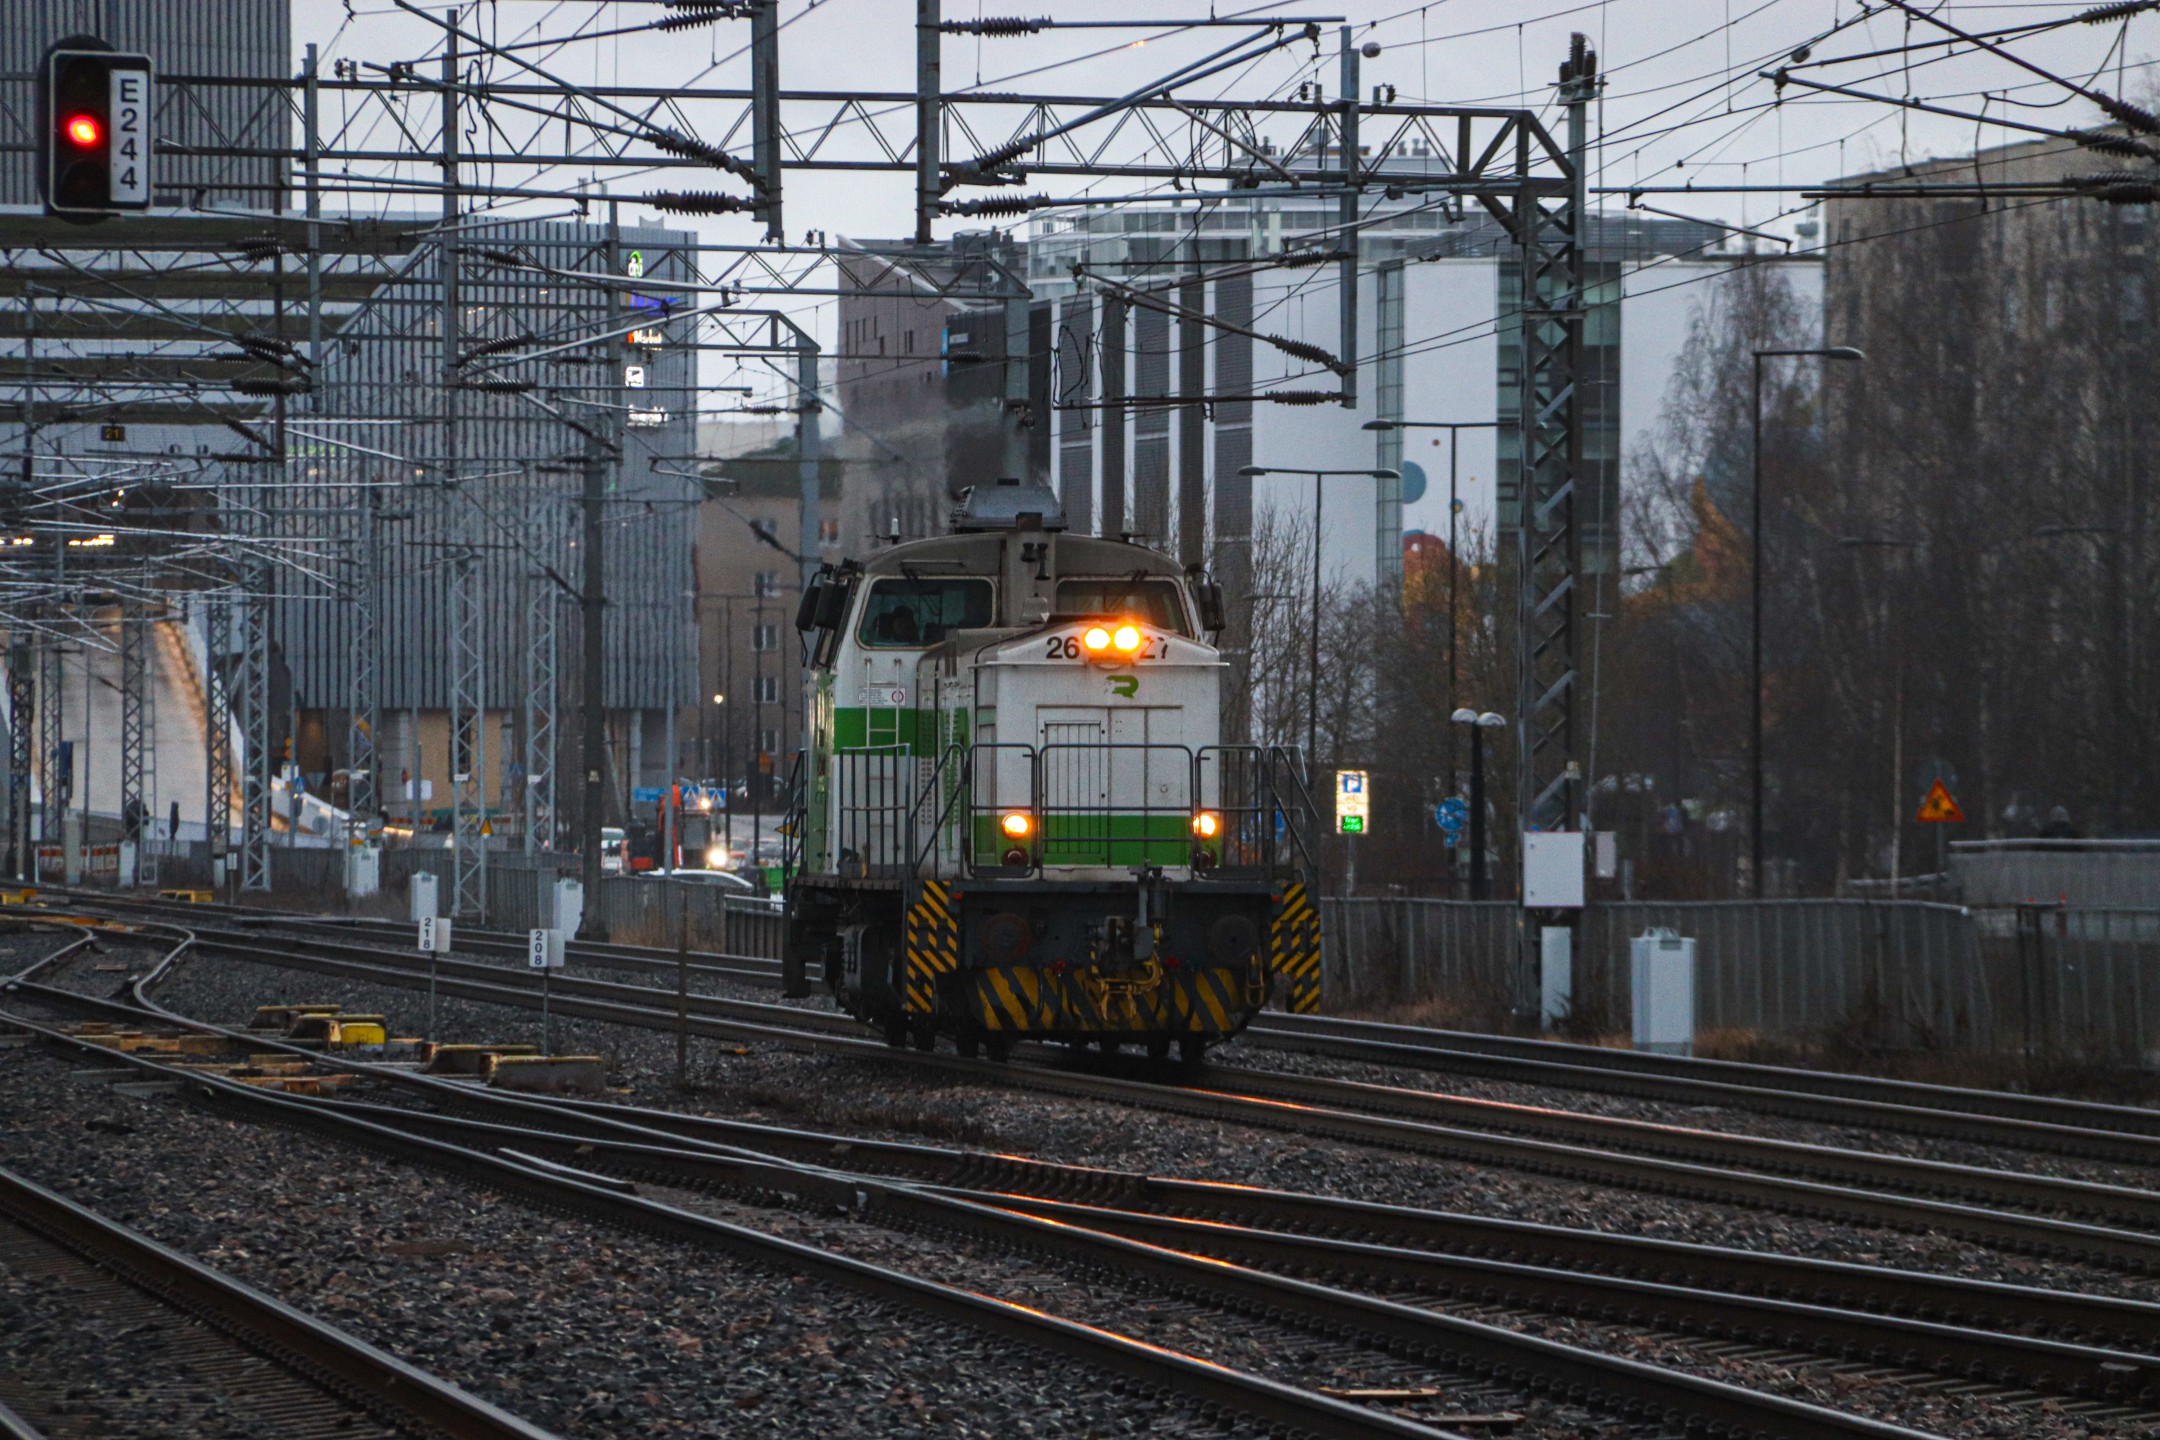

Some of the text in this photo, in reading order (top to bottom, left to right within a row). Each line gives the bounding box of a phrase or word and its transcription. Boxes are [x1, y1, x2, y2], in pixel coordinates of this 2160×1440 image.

[120, 78, 139, 190] E244
[1046, 636, 1081, 659] 26
[423, 917, 432, 949] 218
[534, 930, 543, 966] 208
